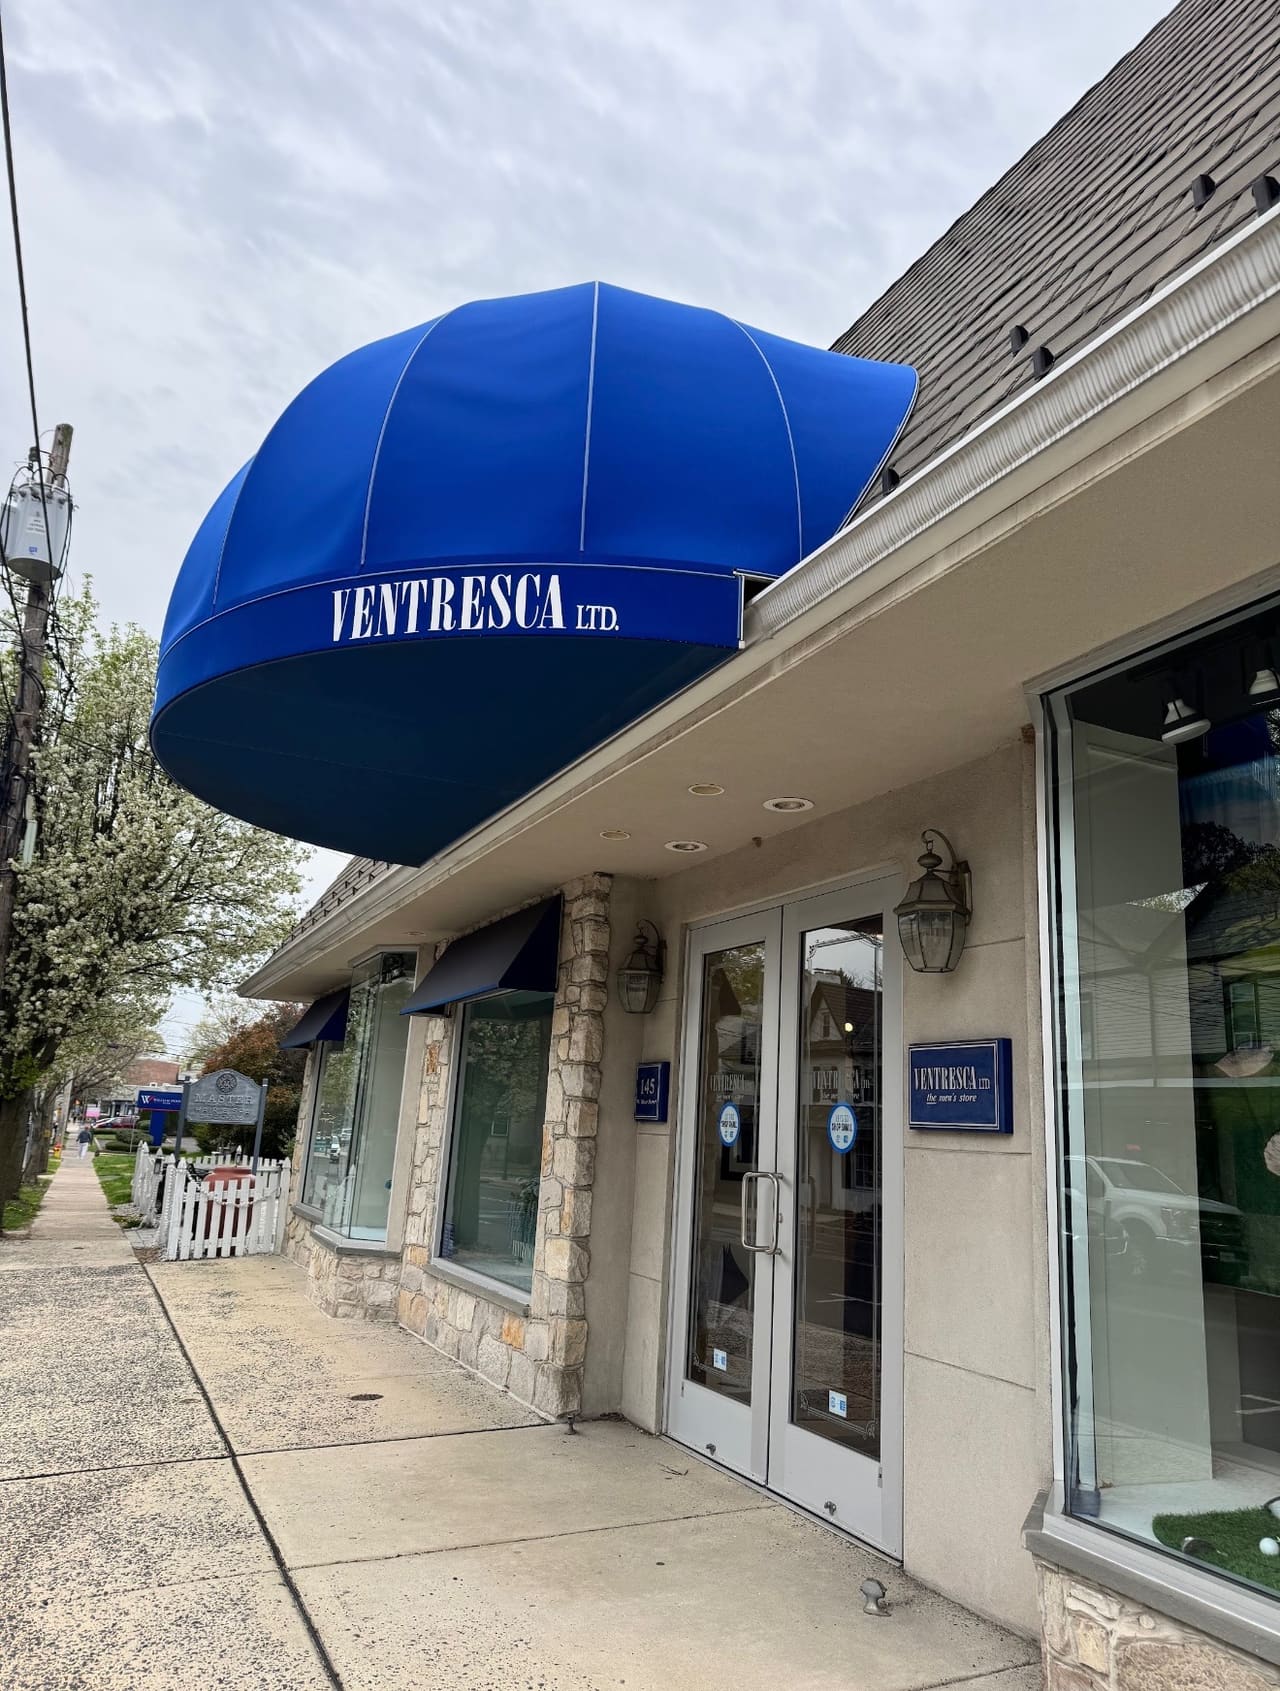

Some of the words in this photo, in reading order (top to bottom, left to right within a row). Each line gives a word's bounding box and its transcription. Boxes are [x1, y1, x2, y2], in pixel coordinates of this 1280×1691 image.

[332, 574, 567, 642] VENTRESCA
[576, 604, 620, 631] LTD.
[640, 1078, 655, 1095] 145
[913, 1066, 977, 1090] VENTRESCA
[194, 1093, 254, 1105] MASTER
[926, 1093, 937, 1104] the
[960, 1093, 977, 1102] store
